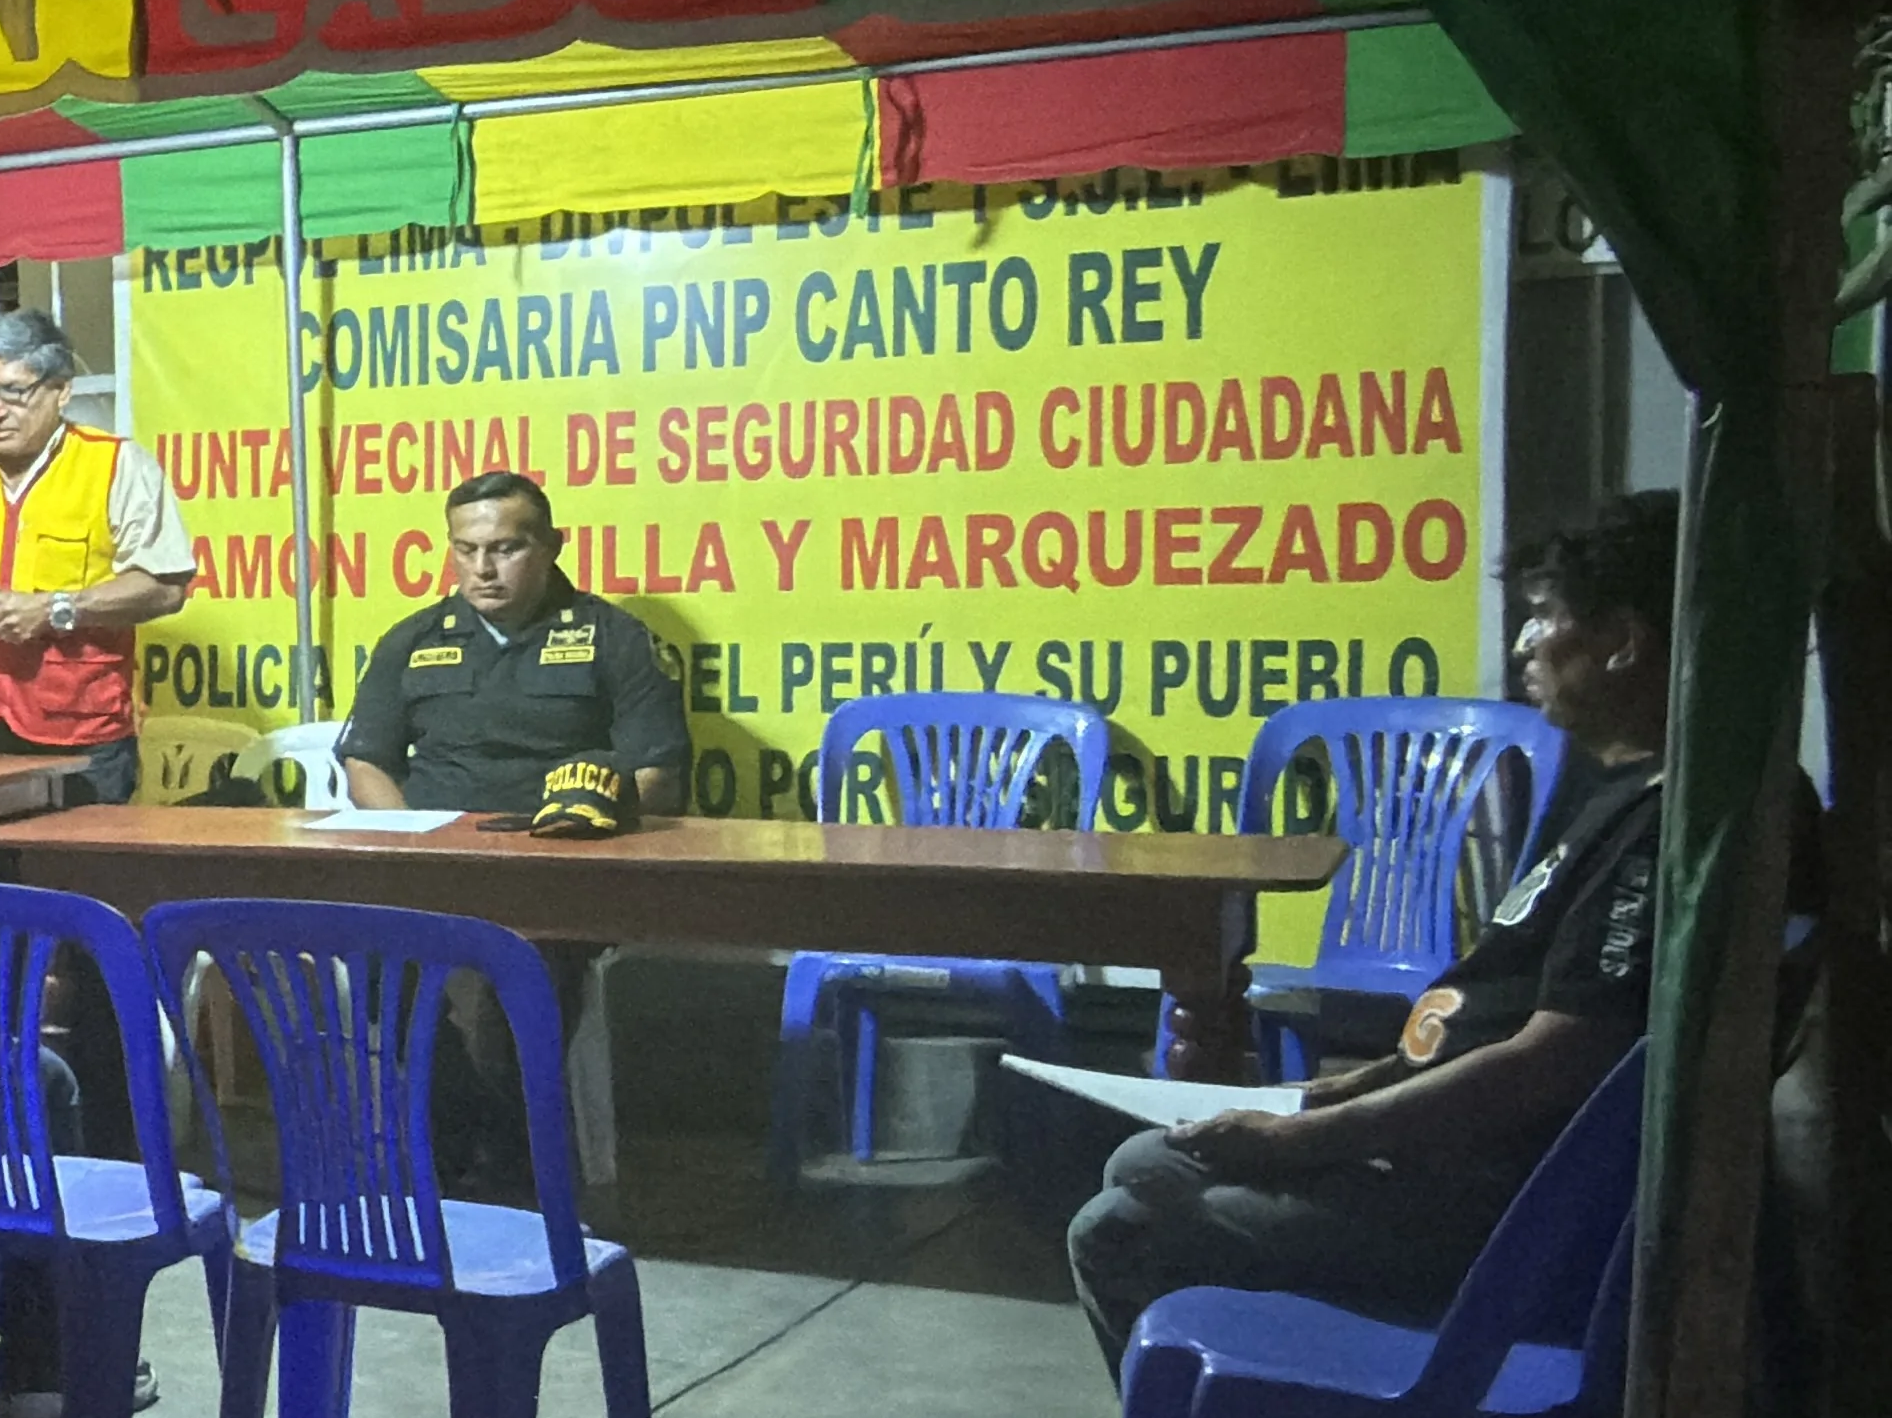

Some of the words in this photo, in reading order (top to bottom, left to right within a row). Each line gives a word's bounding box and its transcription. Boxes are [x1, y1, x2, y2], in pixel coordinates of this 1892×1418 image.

[296, 289, 622, 395] COMISARIA
[642, 275, 771, 373] PNP
[794, 254, 1037, 364] CANTO
[1068, 241, 1222, 347] REY
[319, 415, 547, 496] VECINAL
[566, 410, 637, 486] DE
[657, 391, 1016, 485] SEGURIDAD
[1038, 366, 1463, 470] CIUDADANA
[186, 531, 367, 600] AMON
[391, 521, 737, 598] CILLA
[761, 519, 813, 592] Y
[840, 498, 1468, 594] MARQUEZADO
[143, 642, 335, 709] POLICIA
[780, 622, 944, 714] PERÚ
[967, 640, 1013, 694] Y
[1035, 639, 1123, 718] SU
[1150, 636, 1440, 718] PUEBLO
